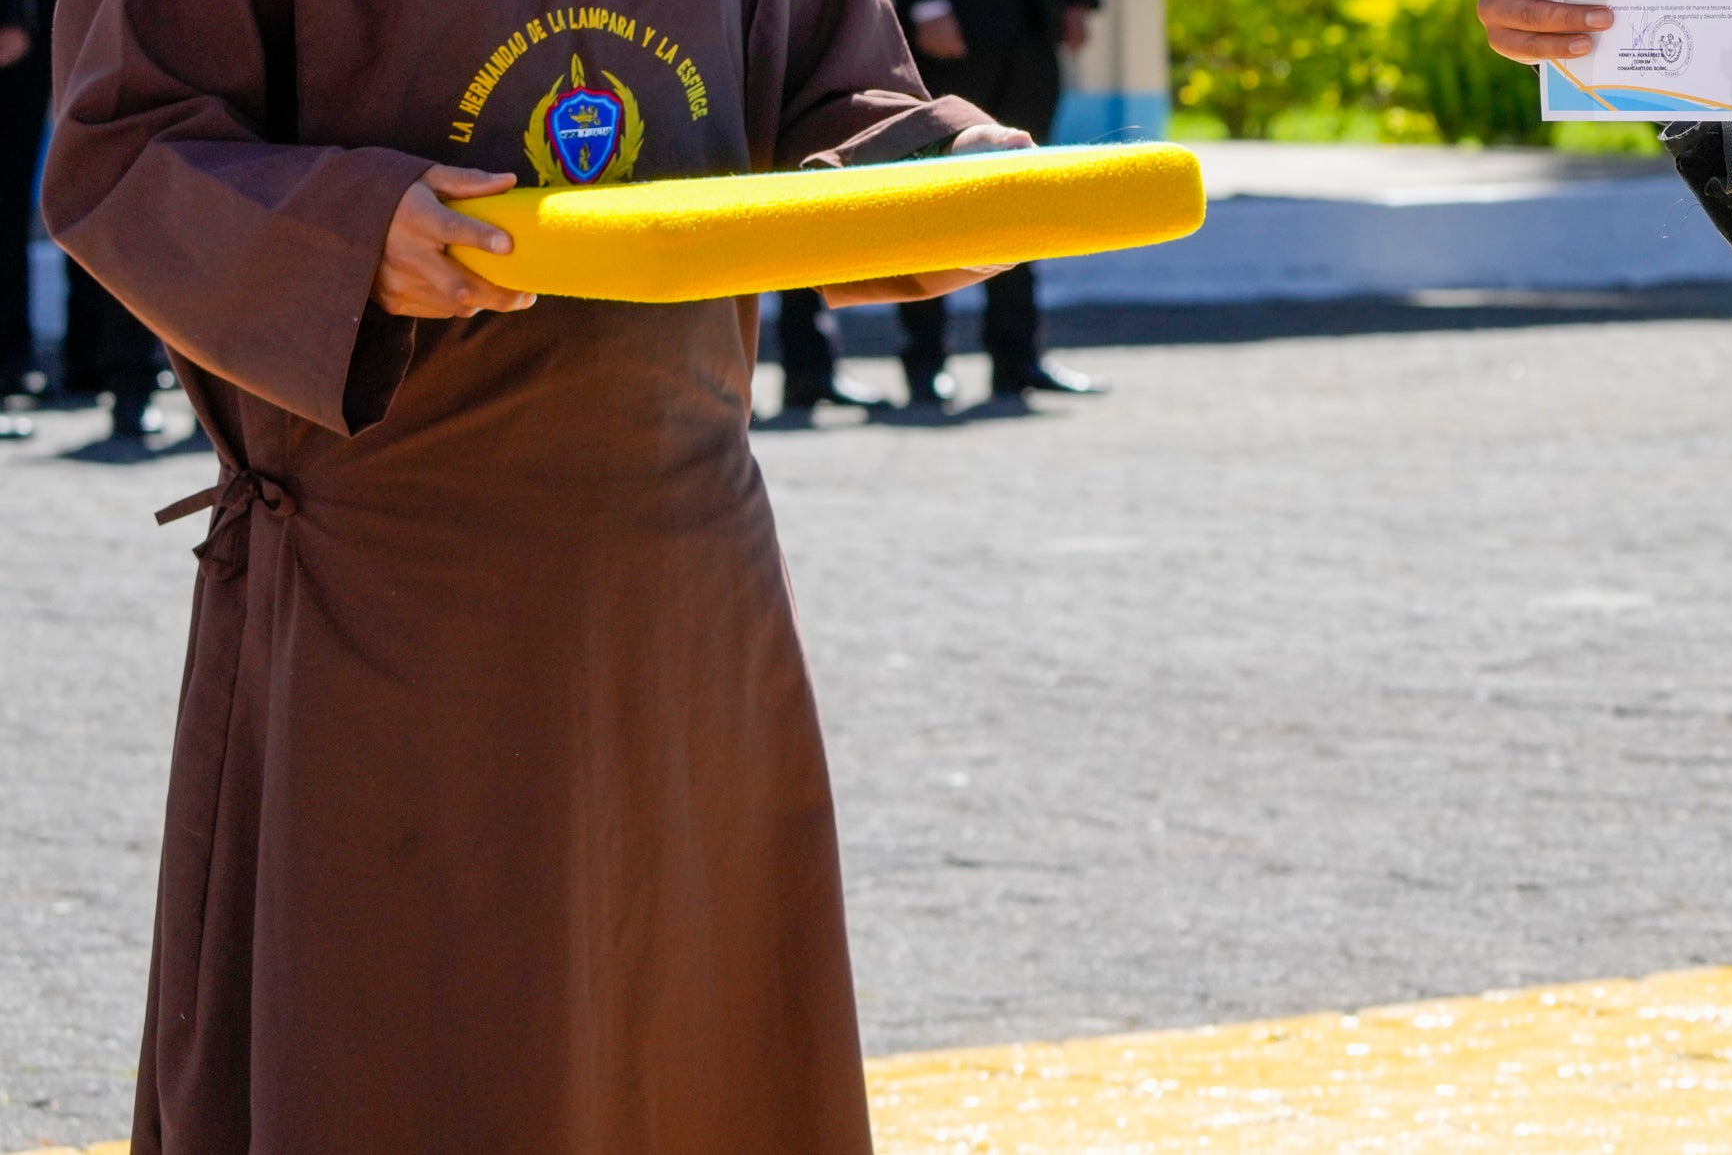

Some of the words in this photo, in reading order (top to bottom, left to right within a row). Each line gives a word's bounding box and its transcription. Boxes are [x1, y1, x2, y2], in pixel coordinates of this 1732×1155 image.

[525, 18, 547, 45] DE
[569, 6, 637, 42] LAMPARA
[642, 26, 656, 48] Y
[655, 36, 680, 65] LA
[459, 31, 529, 116] HERMANDAD
[675, 57, 708, 122] ESFINGE
[449, 119, 474, 144] LA
